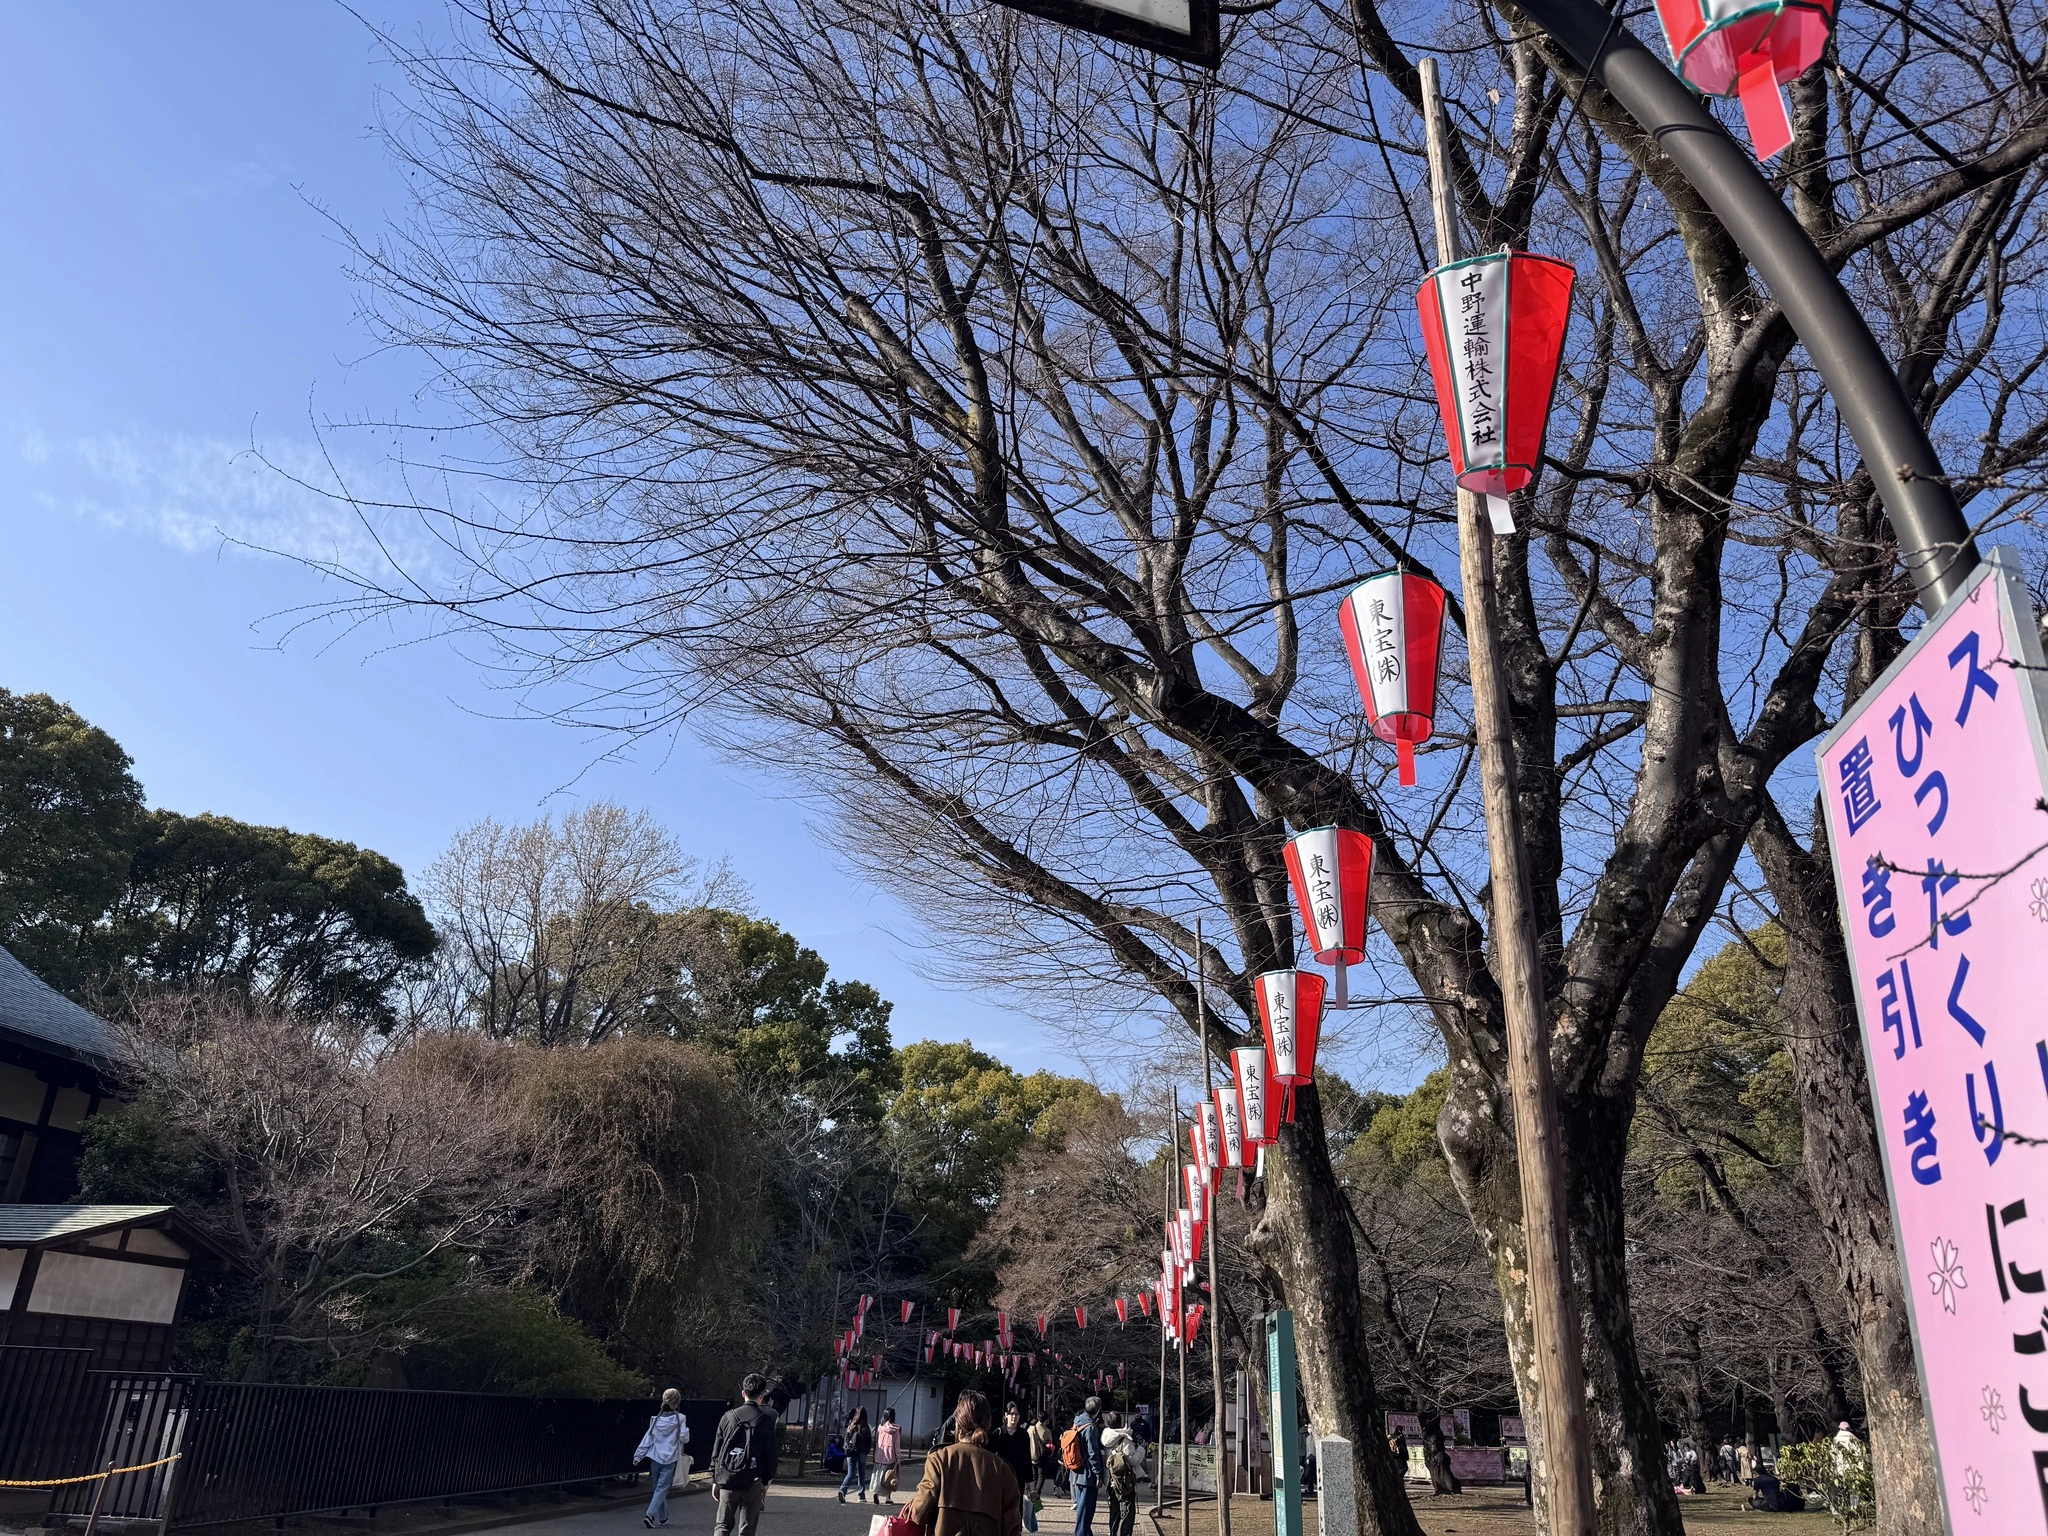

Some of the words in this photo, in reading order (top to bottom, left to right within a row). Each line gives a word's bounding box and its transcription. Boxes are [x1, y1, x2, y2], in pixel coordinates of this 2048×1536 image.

[1461, 272, 1497, 446] 中野運輸株式会社
[1839, 735, 1942, 1186] 置き引き
